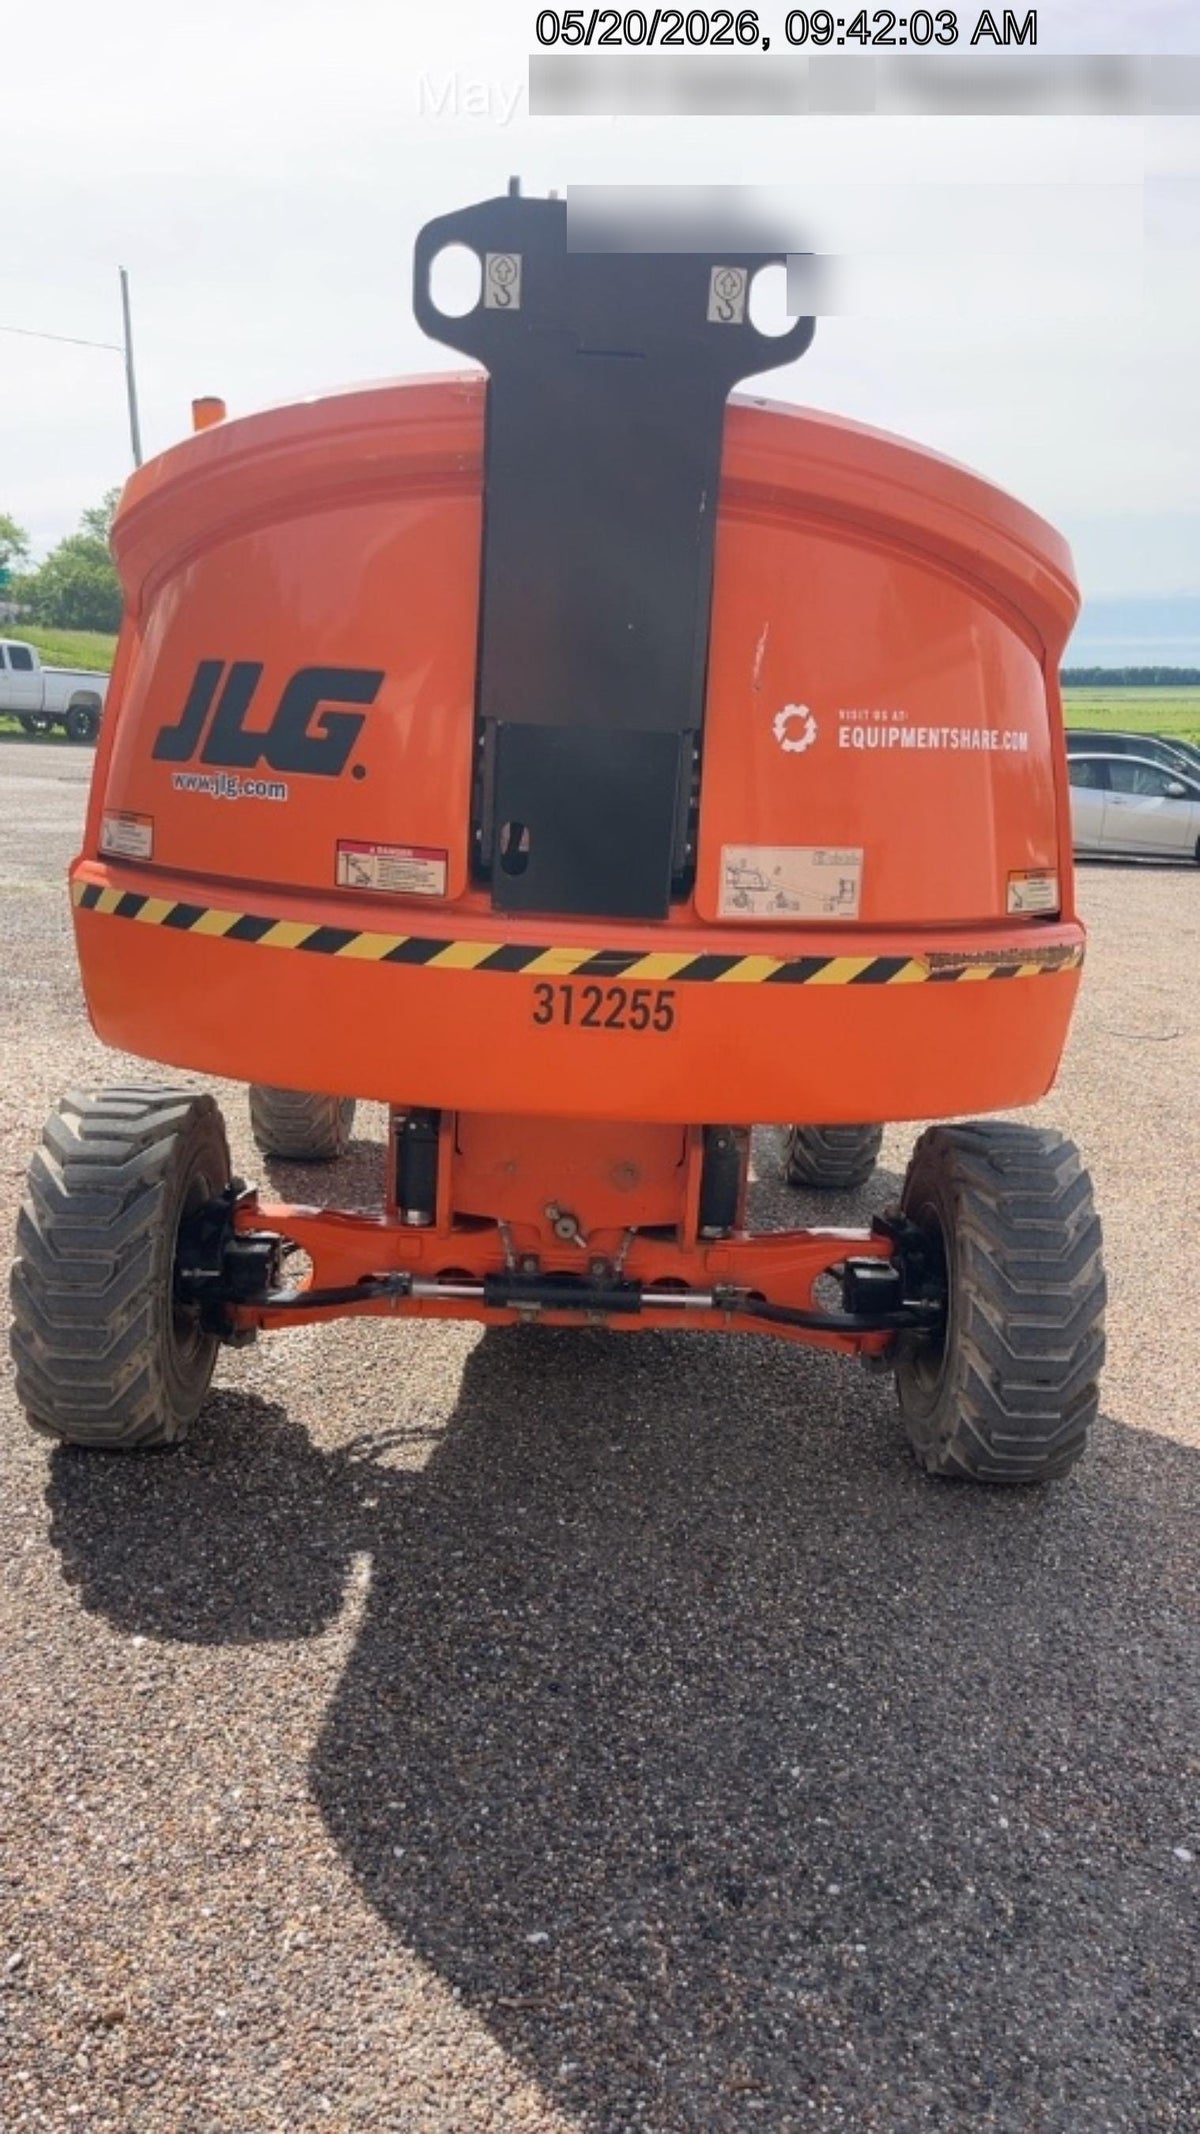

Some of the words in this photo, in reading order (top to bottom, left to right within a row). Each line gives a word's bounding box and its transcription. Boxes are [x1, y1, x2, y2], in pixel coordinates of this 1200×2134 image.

[838, 709, 870, 721] VISIT
[838, 726, 1029, 752] EQUIPMENTSHARE.COM
[171, 772, 288, 801] www.jlg.com
[532, 982, 676, 1032] 312255
